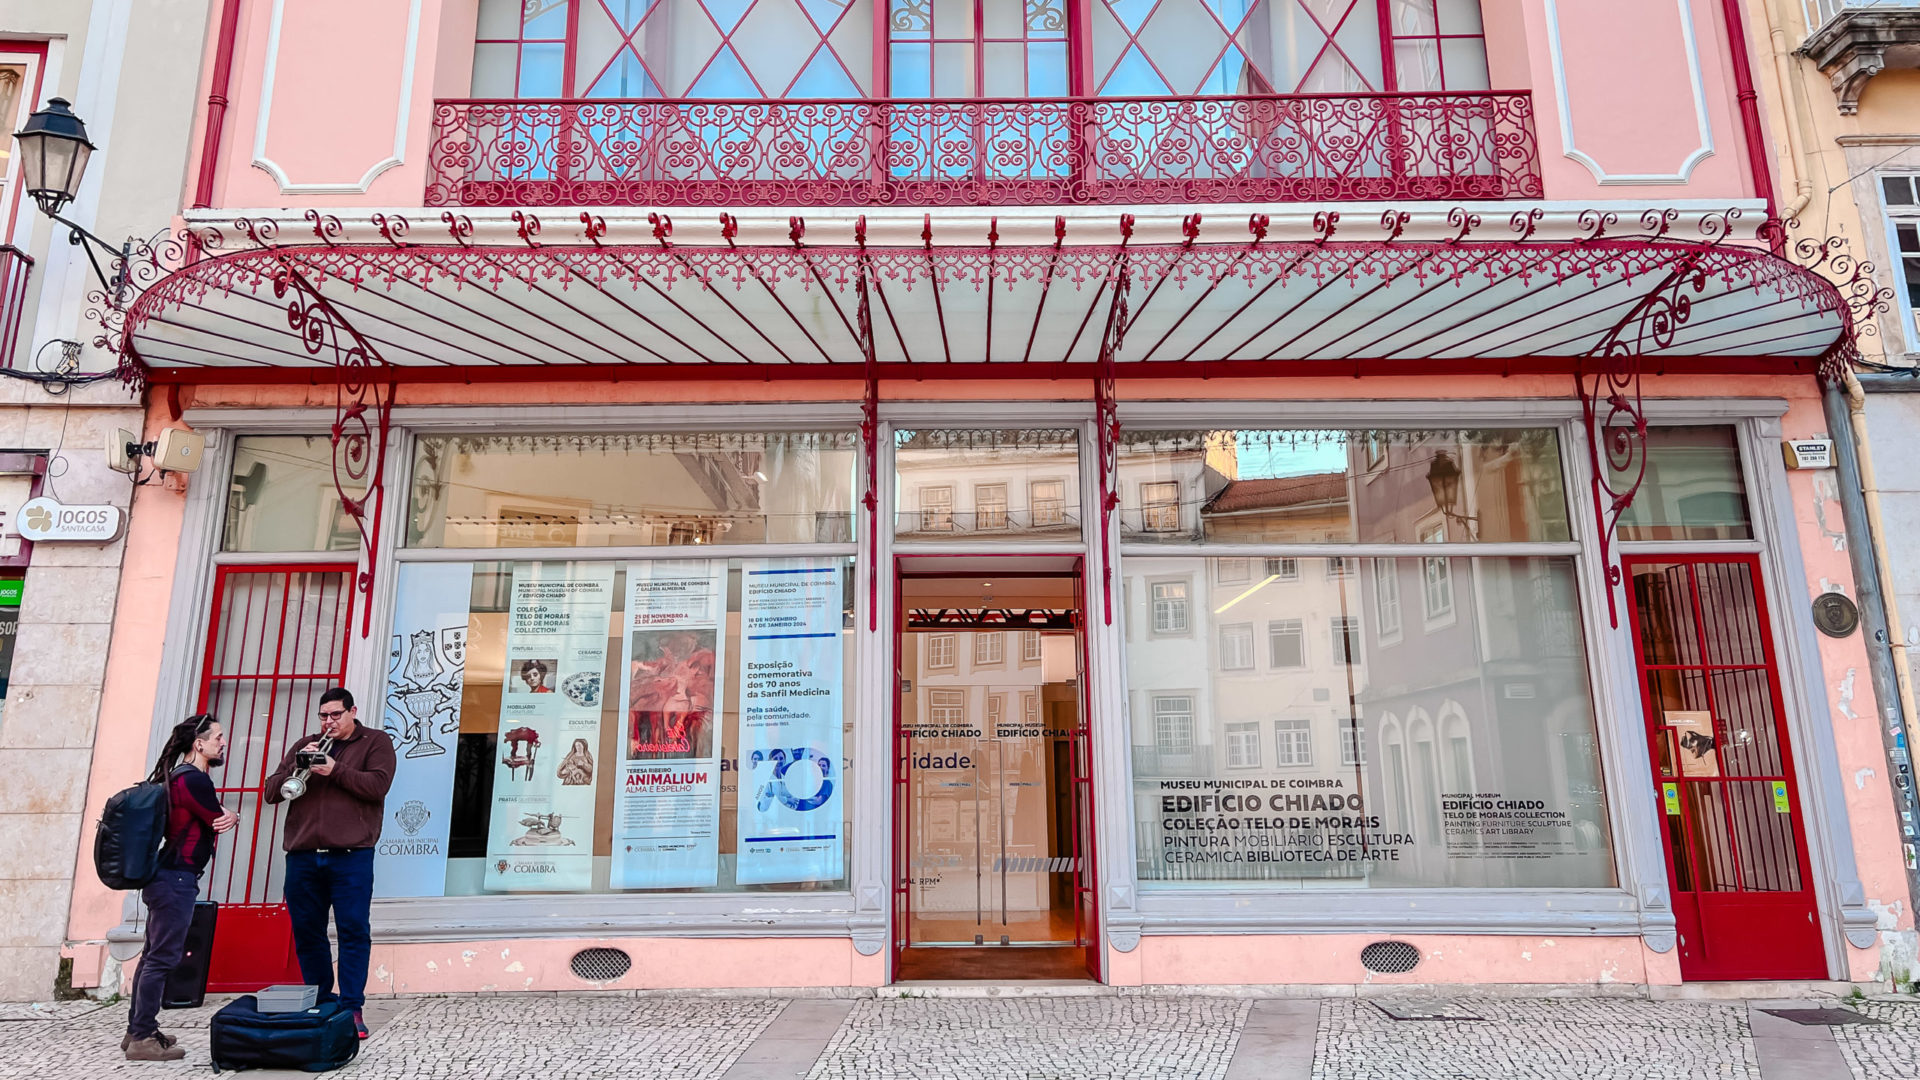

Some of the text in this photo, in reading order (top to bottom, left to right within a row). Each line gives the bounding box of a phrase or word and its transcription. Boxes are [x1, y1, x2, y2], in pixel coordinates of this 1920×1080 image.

[56, 510, 108, 528] JOGOS
[61, 525, 106, 533] SANTACASA
[748, 661, 793, 670] Exposição
[748, 670, 812, 679] comemorativa
[760, 688, 787, 698] Sanfil
[789, 688, 830, 696] Medicina
[746, 712, 812, 722] pela comunidade.
[941, 730, 982, 738] CHIADO
[997, 728, 1040, 737] EDIFÍCIO
[626, 773, 708, 786] ANIMALIUM
[1160, 779, 1344, 789] MUSEU MUNICIPAL DE COIMBRA
[1162, 788, 1362, 812] EDIFÍCIO CHIADO
[1442, 797, 1544, 810] EDIFÍCIO CHIADO
[1162, 814, 1380, 834] COLEÇÃO TELO DE MORAIS
[1164, 832, 1414, 848] PINTURA MOBILIÁRIO ESCULTURA
[379, 844, 440, 856] COIMBRA
[1164, 849, 1400, 863] CERAMICA BIBLIOTECA DE ARTE
[514, 865, 556, 874] COIMBRA
